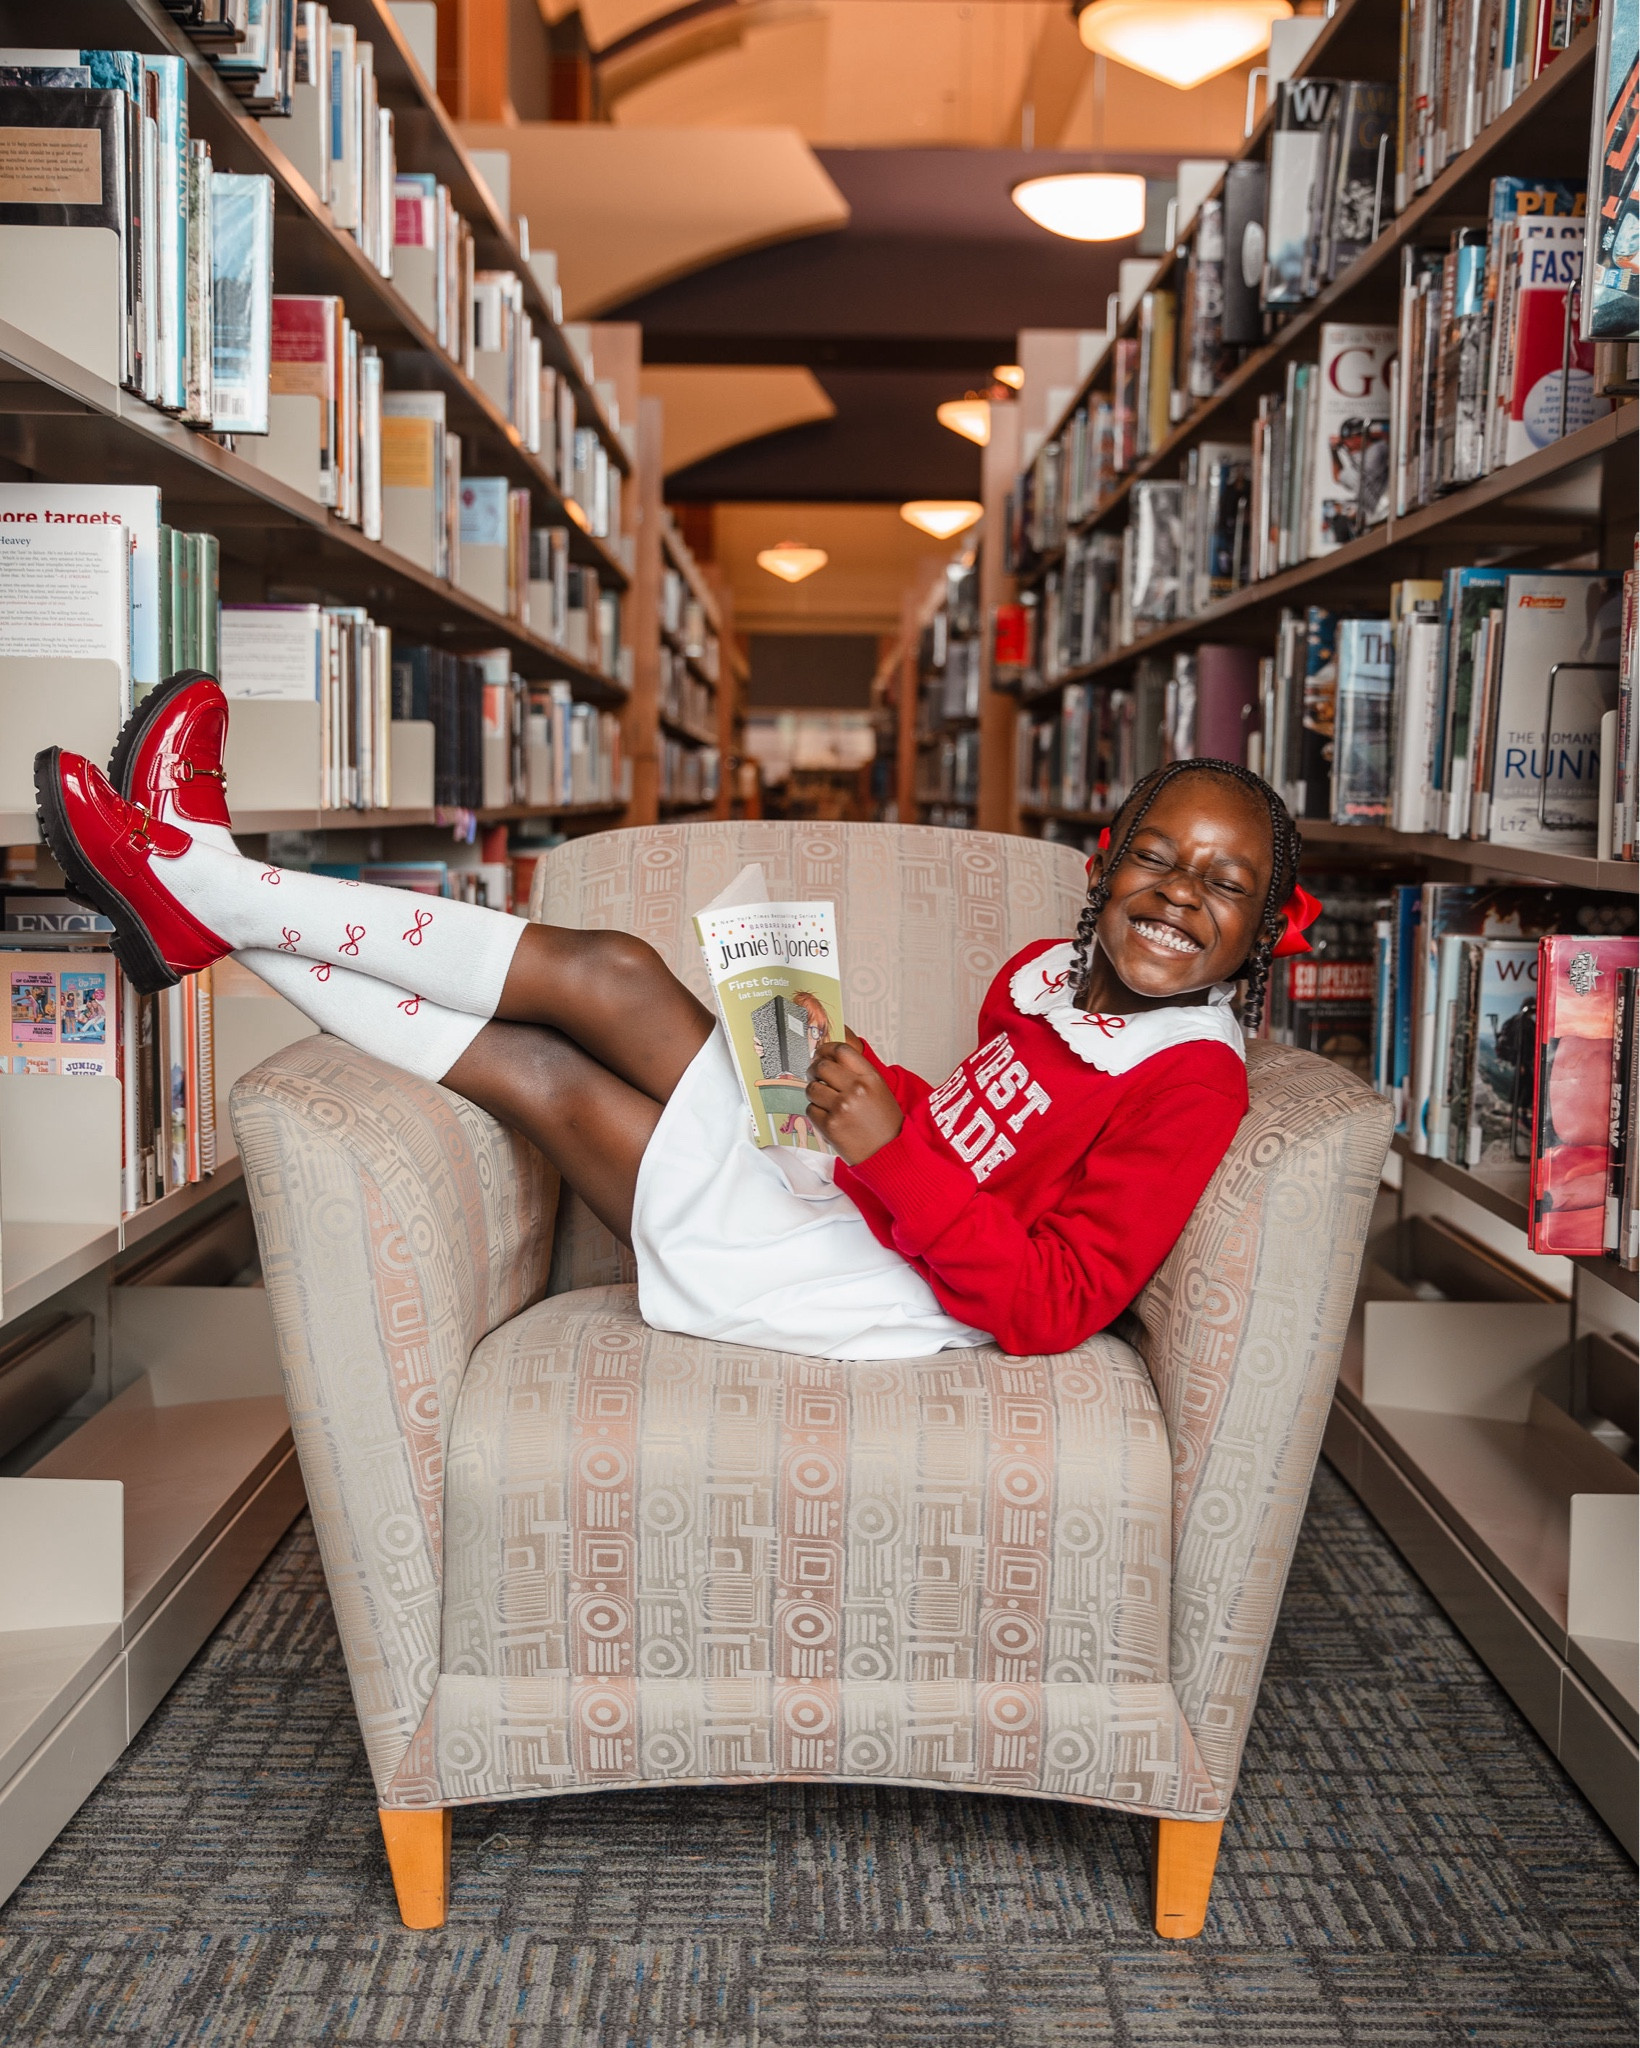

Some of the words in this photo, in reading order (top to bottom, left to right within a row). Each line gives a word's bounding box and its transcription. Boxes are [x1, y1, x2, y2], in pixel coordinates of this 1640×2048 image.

[720, 935, 769, 970] junie
[784, 933, 830, 964] jones
[728, 977, 760, 992] First
[66, 1062, 103, 1073] JUNIOR
[969, 1031, 1053, 1134] FIRST
[928, 1066, 1016, 1184] GRADE
